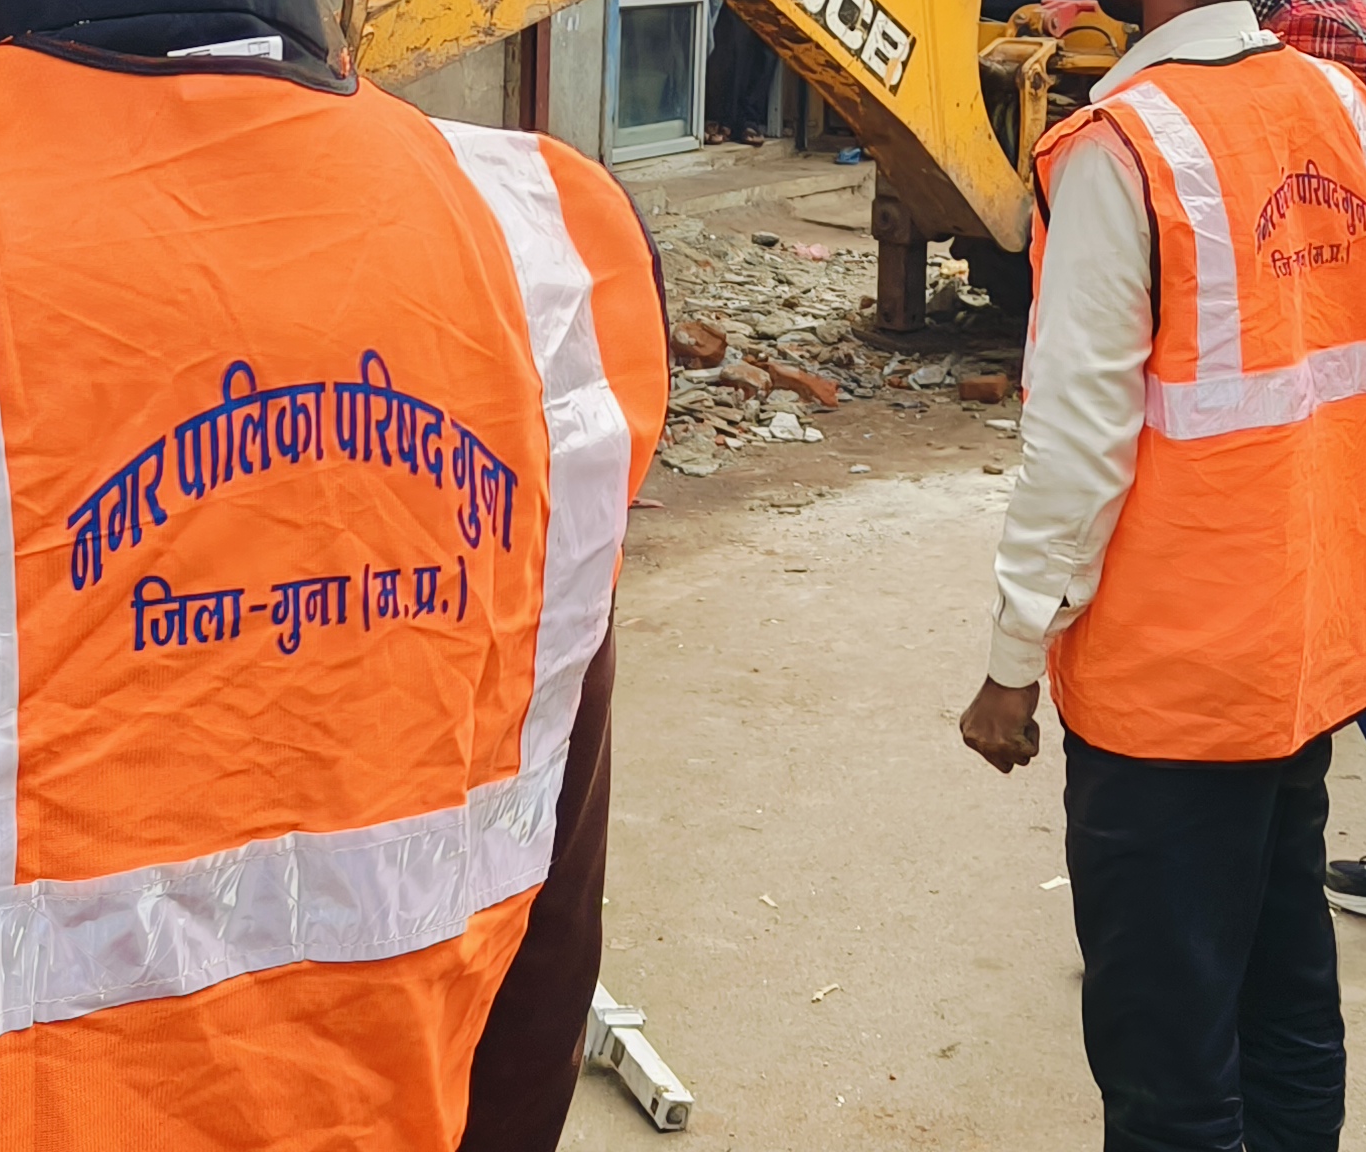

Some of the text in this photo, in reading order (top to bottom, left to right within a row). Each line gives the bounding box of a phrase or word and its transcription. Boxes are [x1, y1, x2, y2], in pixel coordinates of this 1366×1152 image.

[67, 348, 519, 590] नगर पालिका परिषद गुना
[131, 555, 469, 655] जिला-गुना (म.प्र.)
